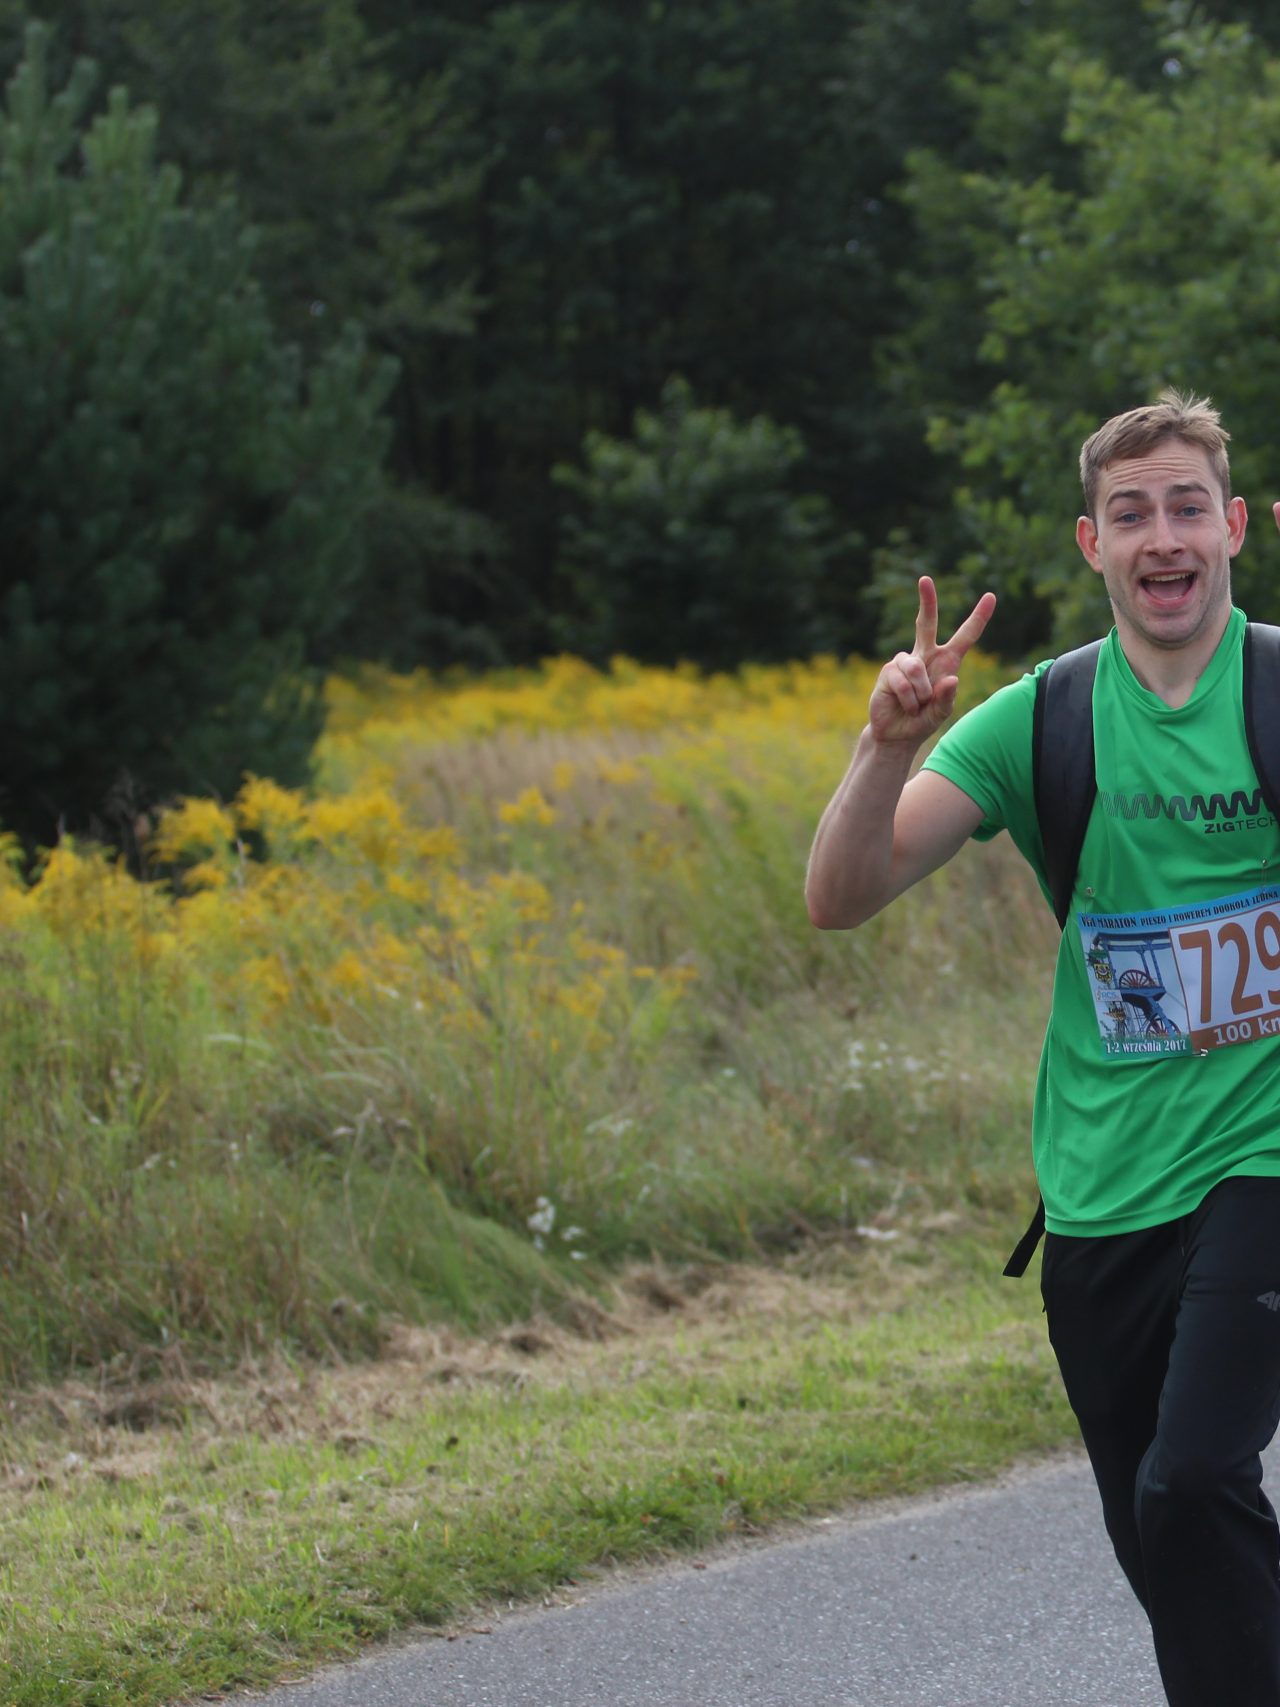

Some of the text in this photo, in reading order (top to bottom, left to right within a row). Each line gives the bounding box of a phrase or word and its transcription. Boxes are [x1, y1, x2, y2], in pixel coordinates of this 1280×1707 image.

[1204, 817, 1278, 834] ZIGTECH
[1097, 915, 1137, 930] MARATON
[1141, 912, 1166, 926] PIESZO
[1174, 907, 1212, 924] ROWEREM
[1213, 898, 1251, 917] DOOKOŁA
[1213, 1022, 1254, 1046] 100
[1163, 1038, 1187, 1053] 2017
